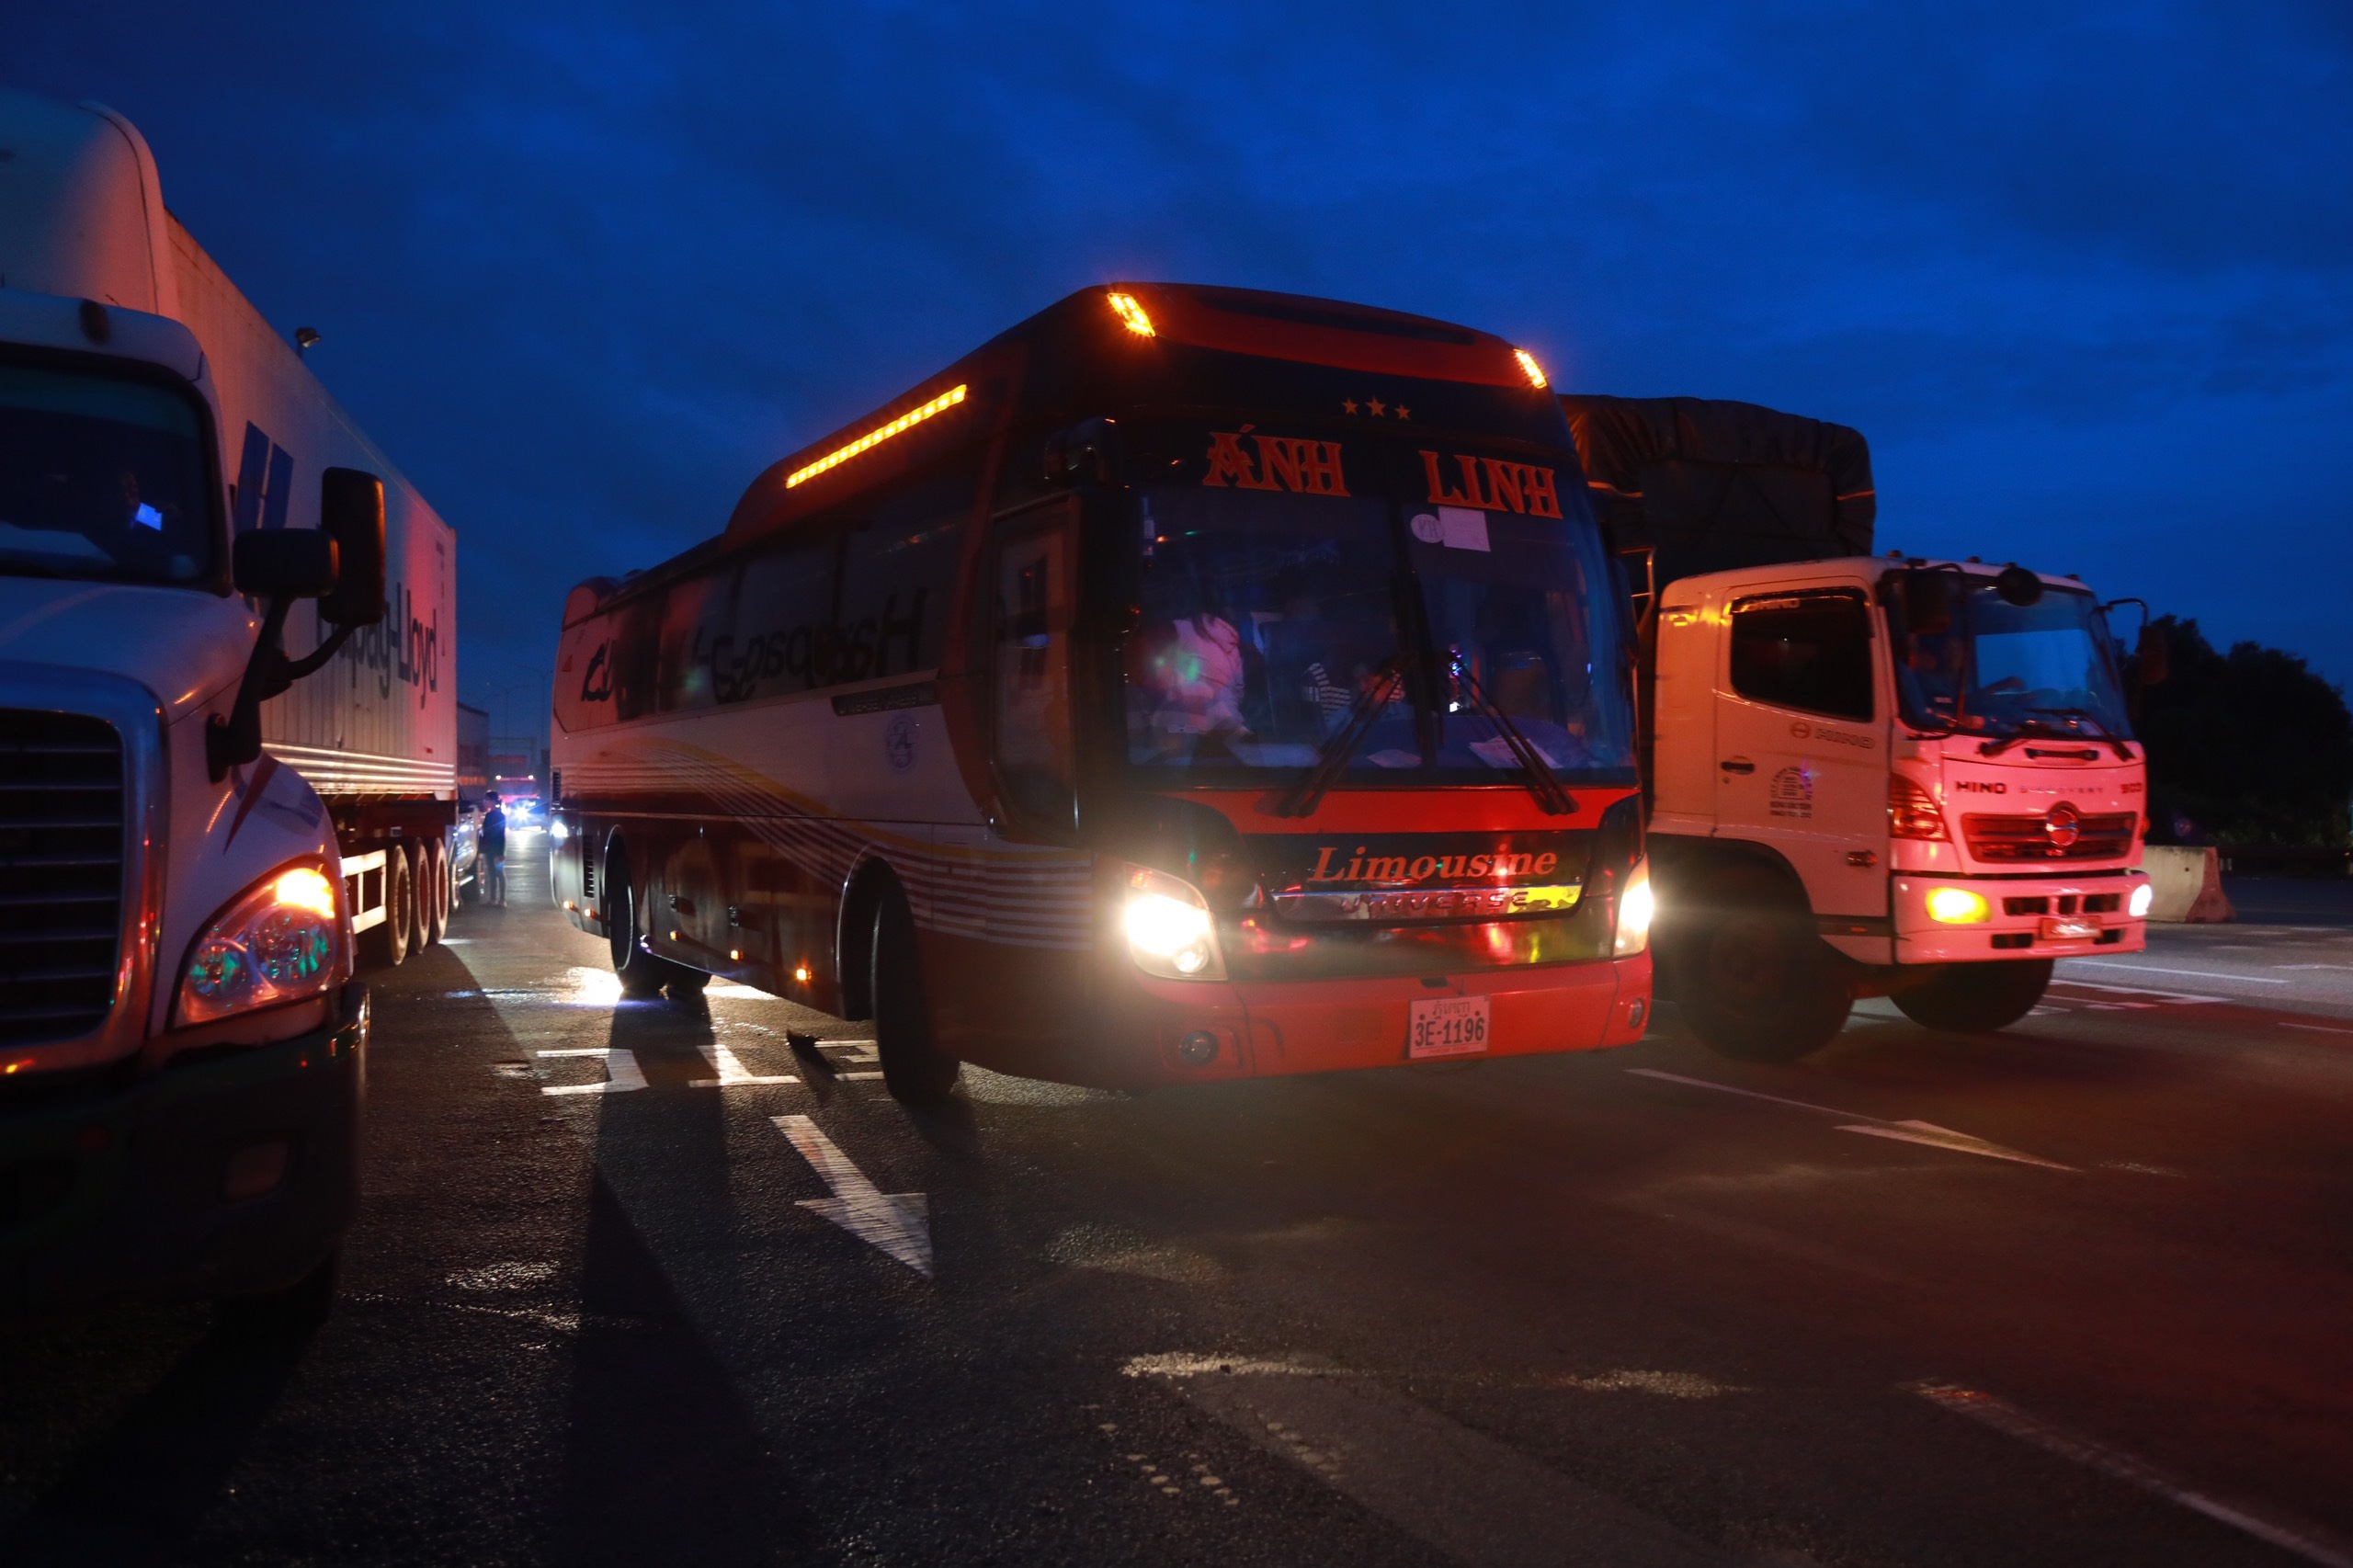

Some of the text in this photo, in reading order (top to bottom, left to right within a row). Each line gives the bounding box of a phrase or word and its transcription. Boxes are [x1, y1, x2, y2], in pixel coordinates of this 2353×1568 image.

[1202, 424, 1563, 520] ÁNH LINH
[320, 583, 437, 710] pag-Lloyd
[1954, 780, 2007, 795] HINO
[1307, 842, 1559, 882] Limousine
[1415, 1017, 1485, 1048] 3E-1196
